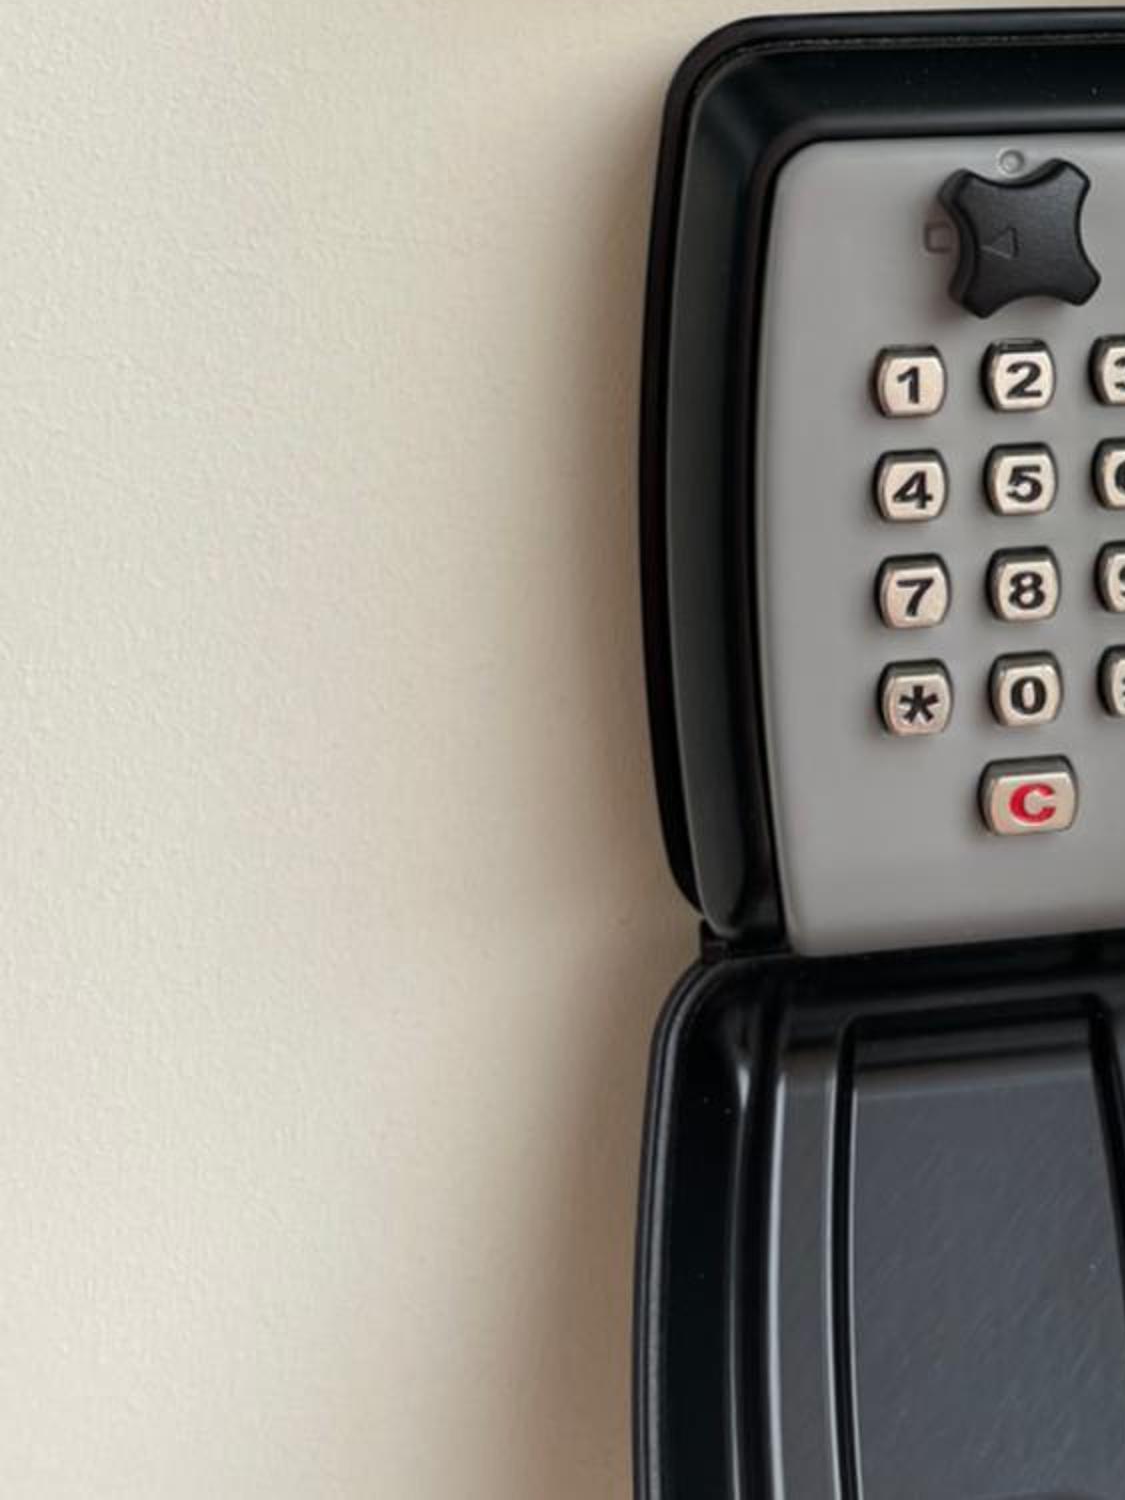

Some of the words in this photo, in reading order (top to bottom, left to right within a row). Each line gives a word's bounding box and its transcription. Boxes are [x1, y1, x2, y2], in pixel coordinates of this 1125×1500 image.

[897, 366, 920, 405] 1
[1005, 360, 1043, 399] 2
[892, 470, 934, 510] 4
[1006, 464, 1043, 504] 5
[896, 577, 935, 617] 7
[1008, 571, 1046, 610] 8
[1010, 676, 1047, 715] 0
[1008, 783, 1057, 823] C
